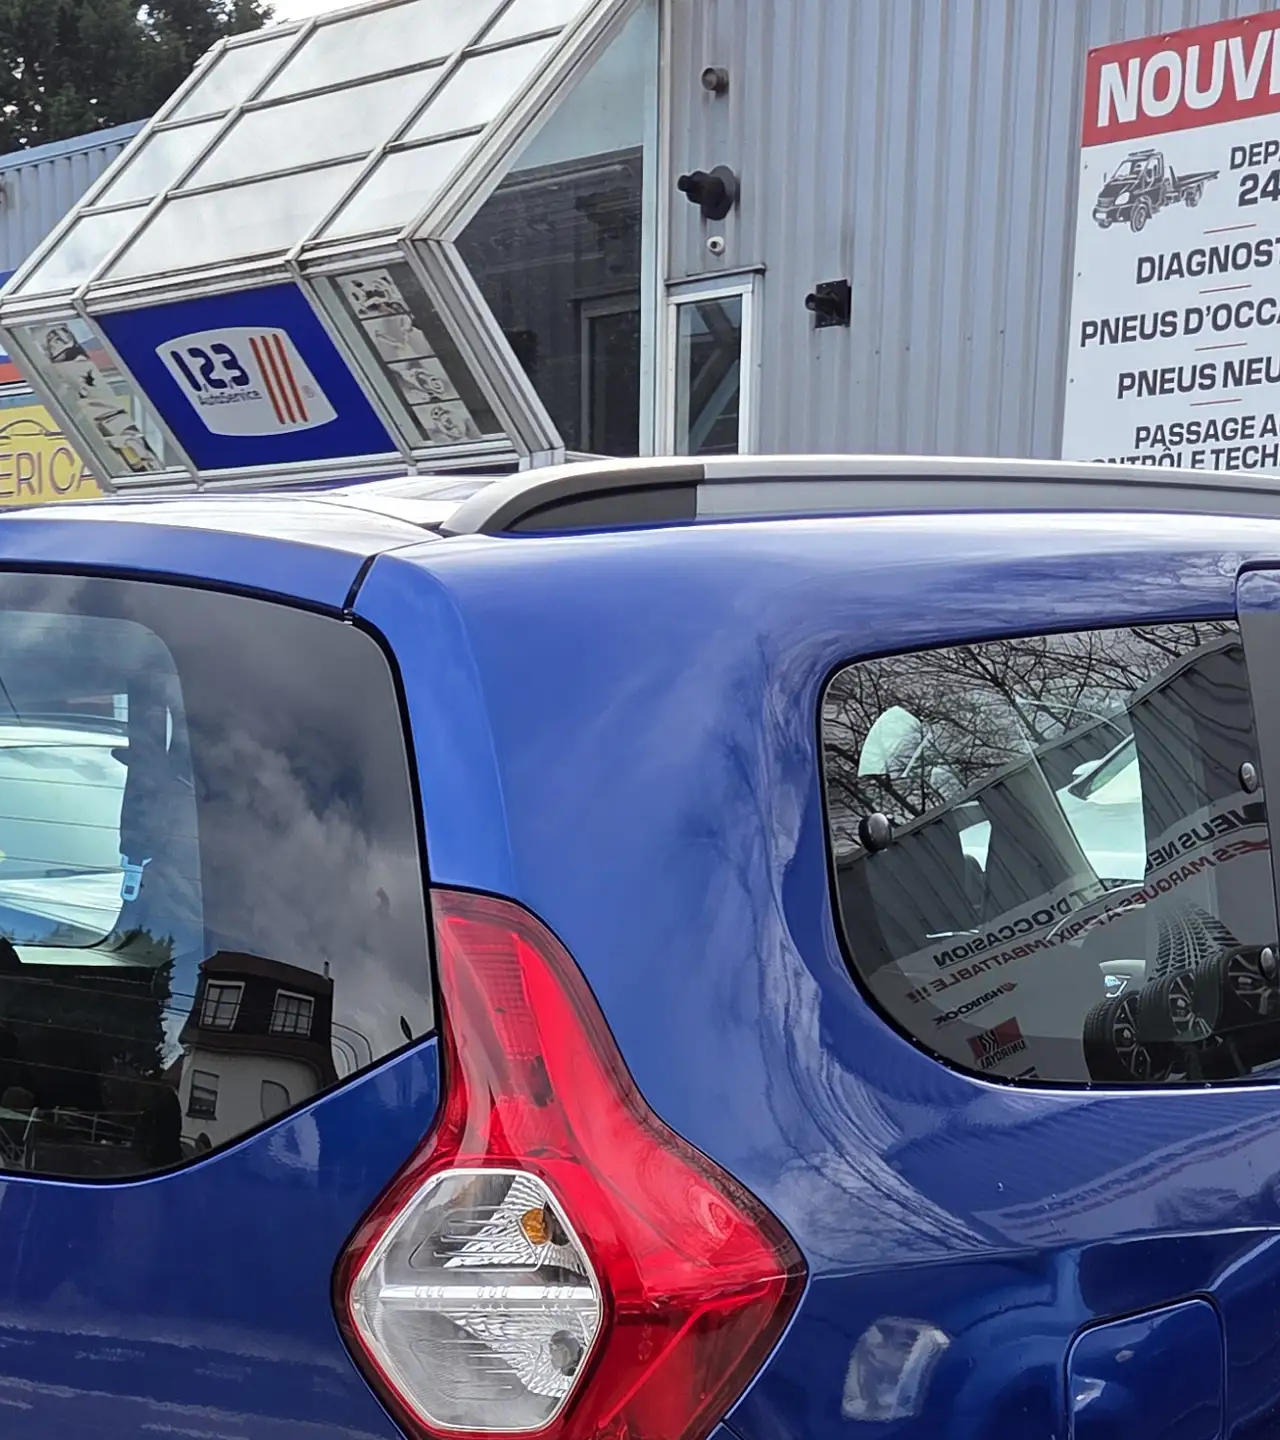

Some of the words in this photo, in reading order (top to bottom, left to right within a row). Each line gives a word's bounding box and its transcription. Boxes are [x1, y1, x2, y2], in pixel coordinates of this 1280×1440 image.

[1081, 310, 1177, 347] PNEUS
[169, 343, 250, 392] 123
[1117, 362, 1216, 399] PNEUS
[1135, 415, 1255, 449] PASSAGE
